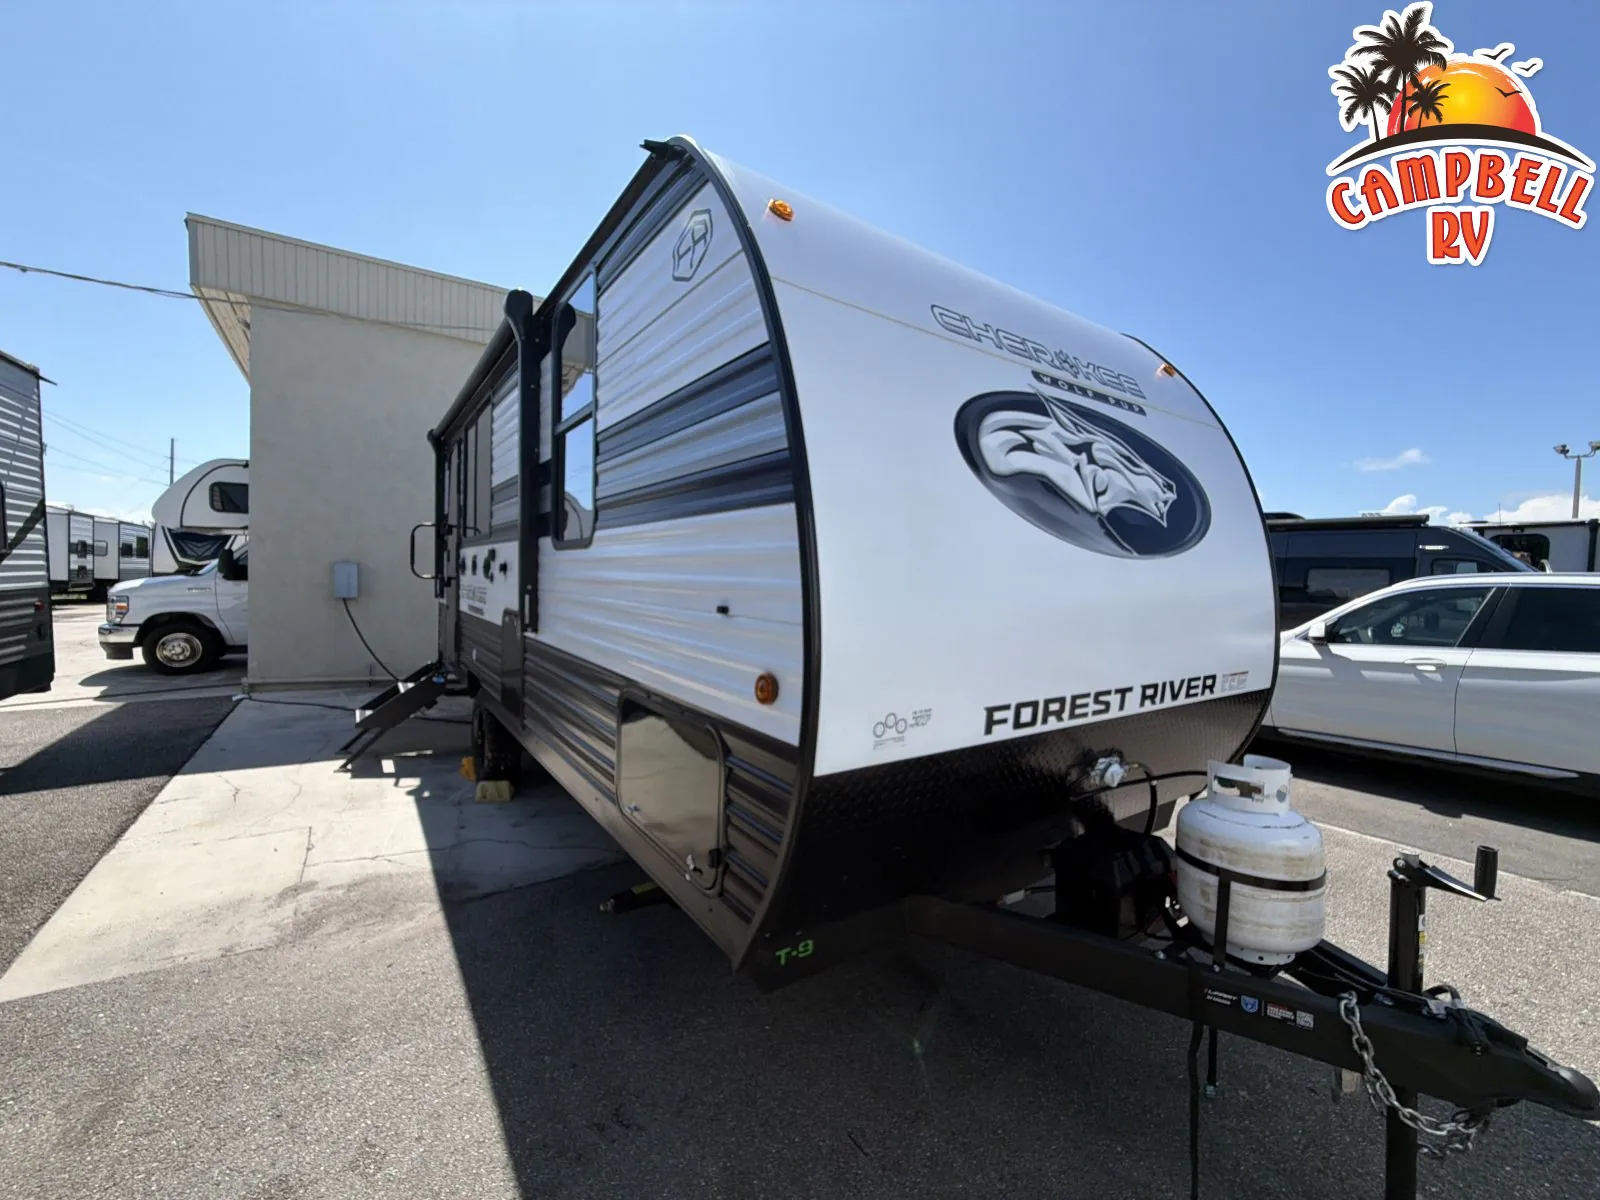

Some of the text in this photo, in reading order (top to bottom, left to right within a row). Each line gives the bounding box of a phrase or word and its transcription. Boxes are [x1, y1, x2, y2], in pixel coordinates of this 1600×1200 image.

[1039, 373, 1095, 398] WOLF
[983, 687, 1134, 736] FOREST
[1139, 674, 1217, 707] RIVER
[775, 939, 814, 966] T-9
